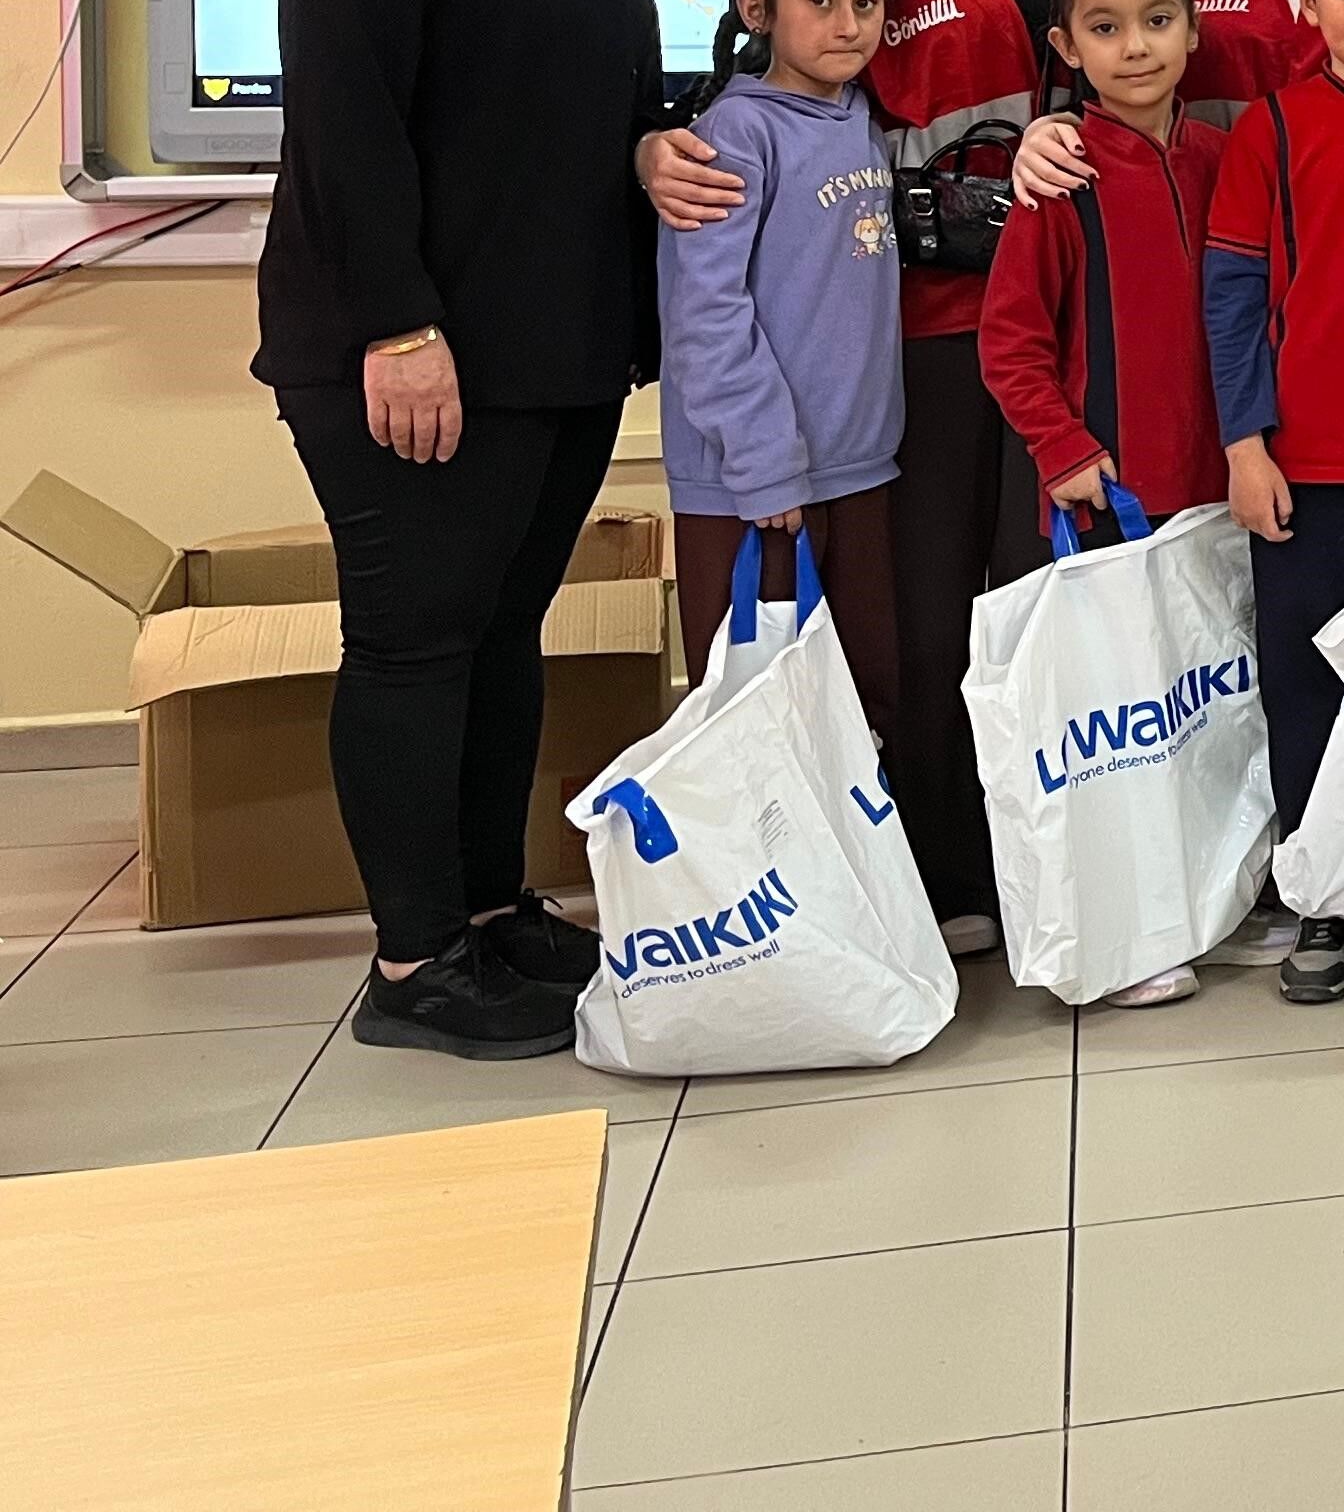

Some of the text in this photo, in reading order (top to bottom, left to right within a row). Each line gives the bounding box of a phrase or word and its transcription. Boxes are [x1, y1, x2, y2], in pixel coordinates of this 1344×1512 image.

[1107, 750, 1167, 773] deserves
[621, 939, 781, 999] deserves to dress well
